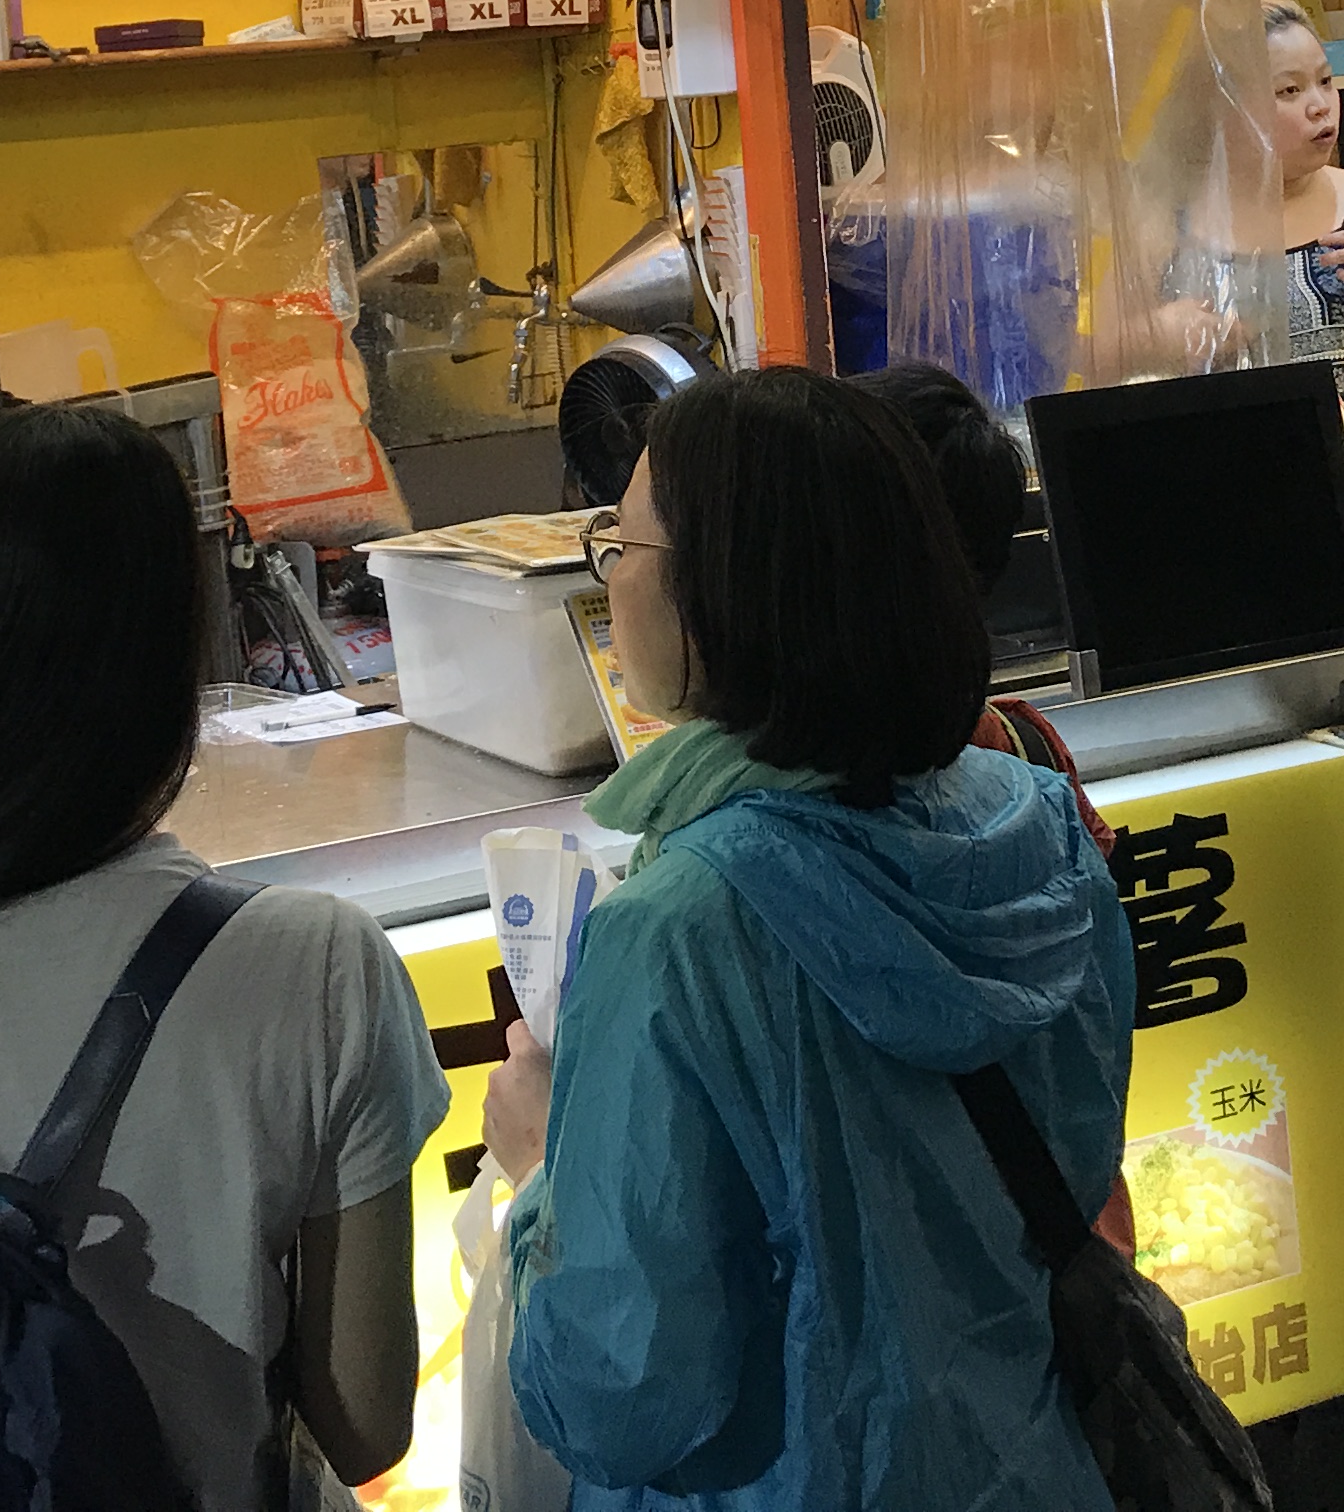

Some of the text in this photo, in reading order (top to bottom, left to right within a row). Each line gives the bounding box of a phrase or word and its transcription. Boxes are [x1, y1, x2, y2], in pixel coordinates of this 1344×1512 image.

[390, 7, 425, 27] XL
[468, 1, 503, 21] XL
[1210, 1079, 1267, 1122] 玉米
